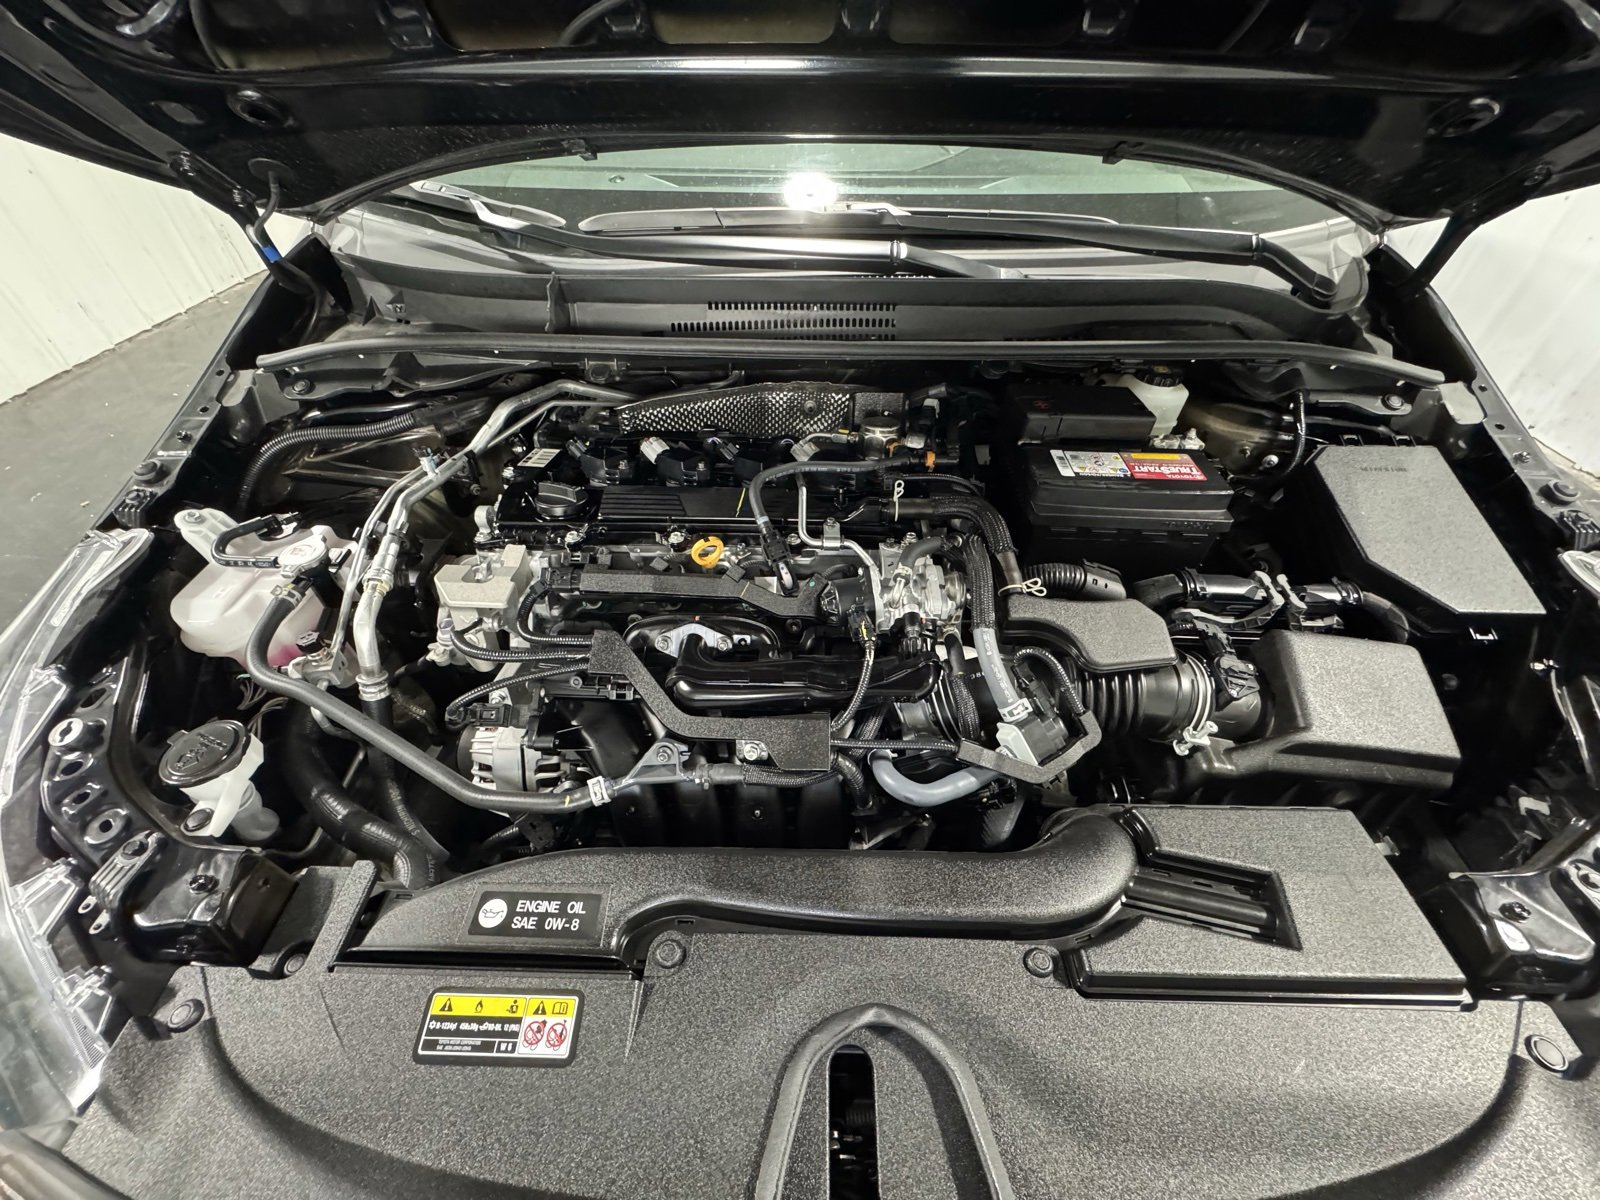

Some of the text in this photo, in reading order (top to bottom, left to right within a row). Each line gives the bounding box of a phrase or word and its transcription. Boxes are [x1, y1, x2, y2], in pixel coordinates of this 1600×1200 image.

[516, 900, 586, 914] ENGINE OIL
[511, 916, 580, 931] SAE 0W-8
